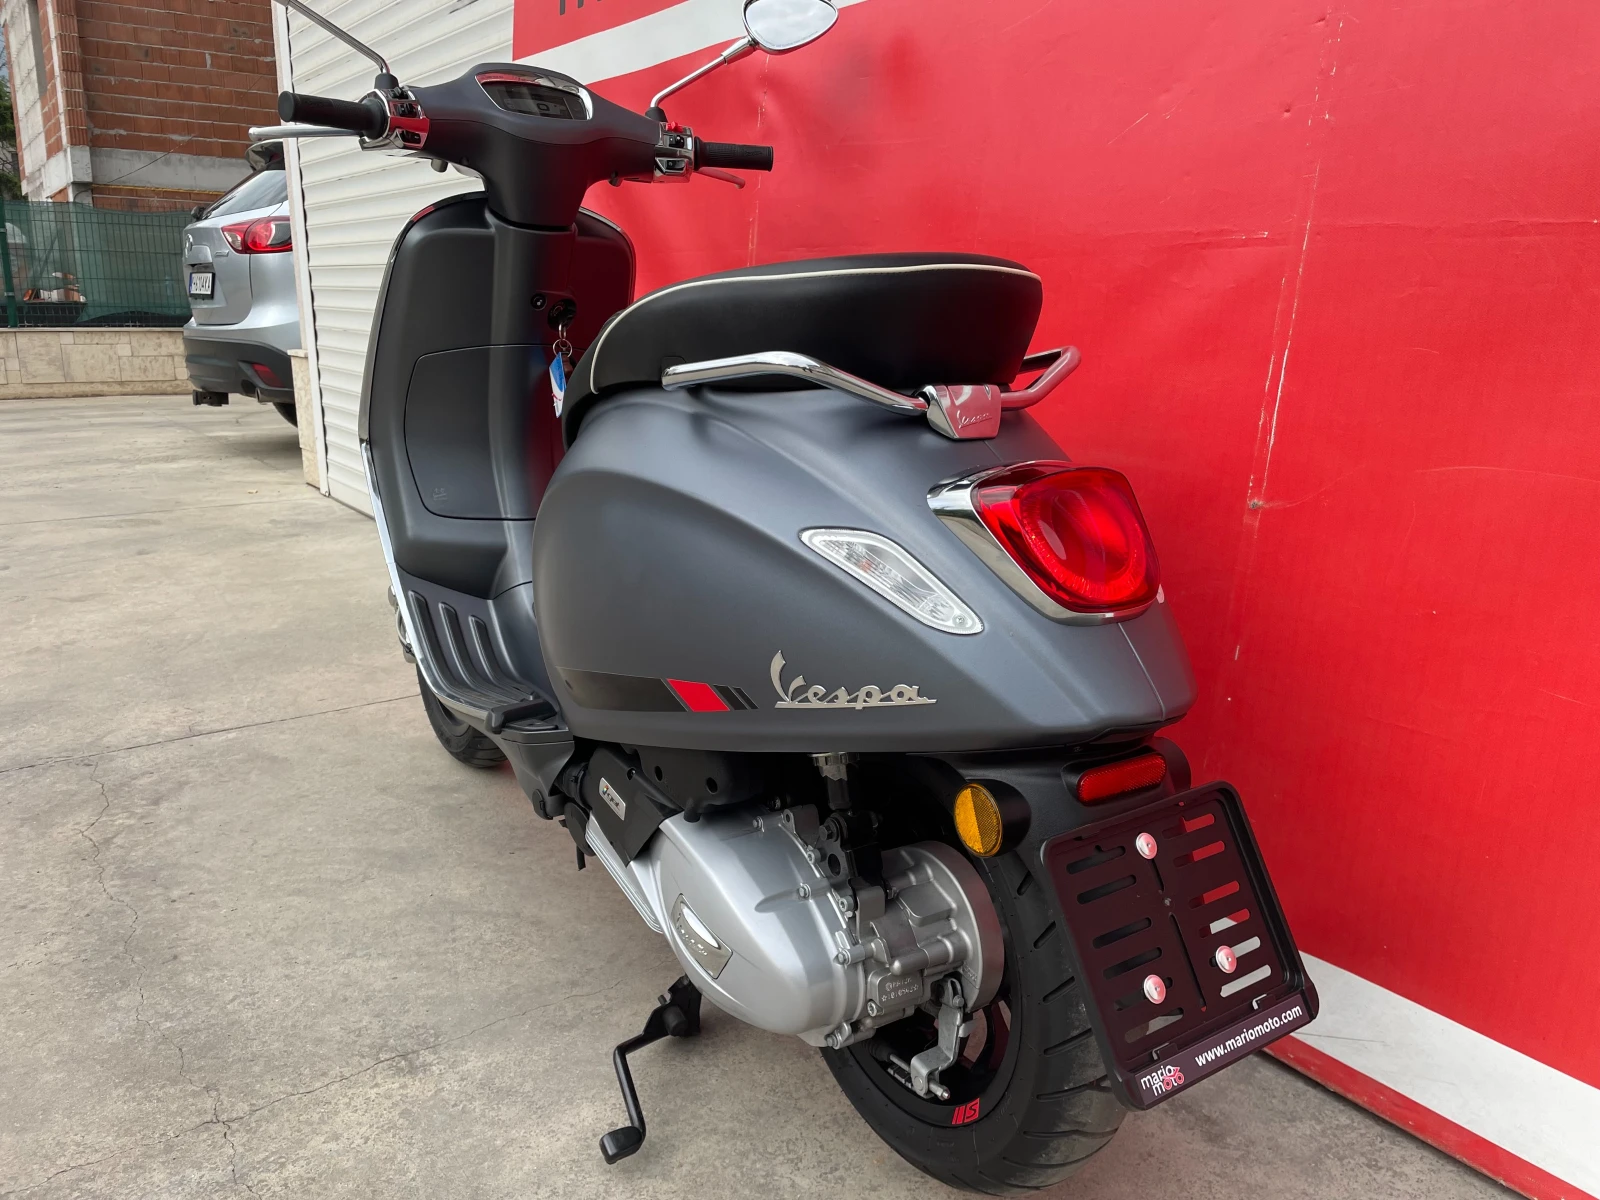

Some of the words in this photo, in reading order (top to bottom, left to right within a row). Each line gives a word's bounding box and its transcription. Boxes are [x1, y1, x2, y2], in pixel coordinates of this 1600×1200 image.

[770, 650, 937, 709] Vespa
[1194, 1005, 1303, 1067] www.mariomoto.com
[1140, 1065, 1174, 1090] mario
